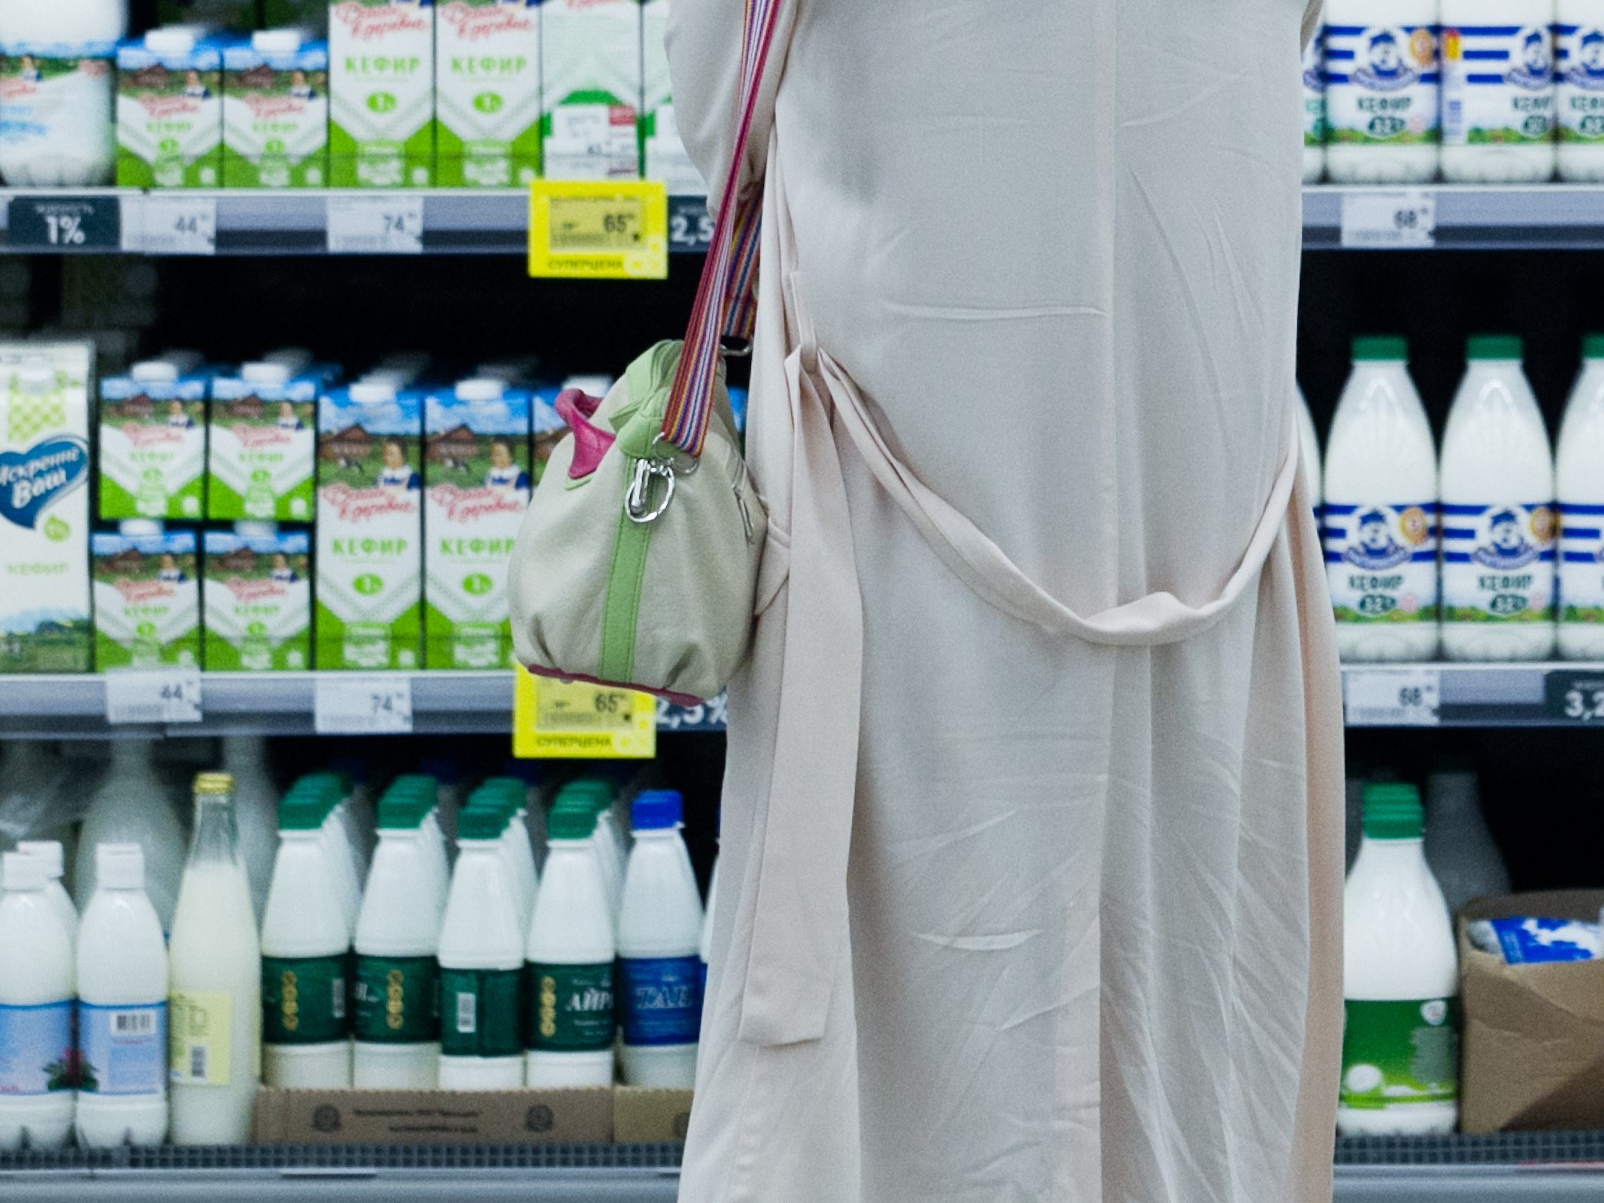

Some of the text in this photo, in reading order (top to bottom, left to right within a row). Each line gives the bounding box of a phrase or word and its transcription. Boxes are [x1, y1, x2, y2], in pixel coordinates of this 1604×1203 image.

[344, 56, 420, 74] КЕФИР
[452, 56, 527, 74] КЕФИР
[45, 215, 85, 244] 1%
[603, 214, 628, 233] 65
[671, 217, 715, 246] 2,5
[11, 471, 67, 509] Ваш
[332, 538, 407, 556] КЕФИР
[440, 537, 515, 556] КЕФИР
[594, 694, 618, 713] 65
